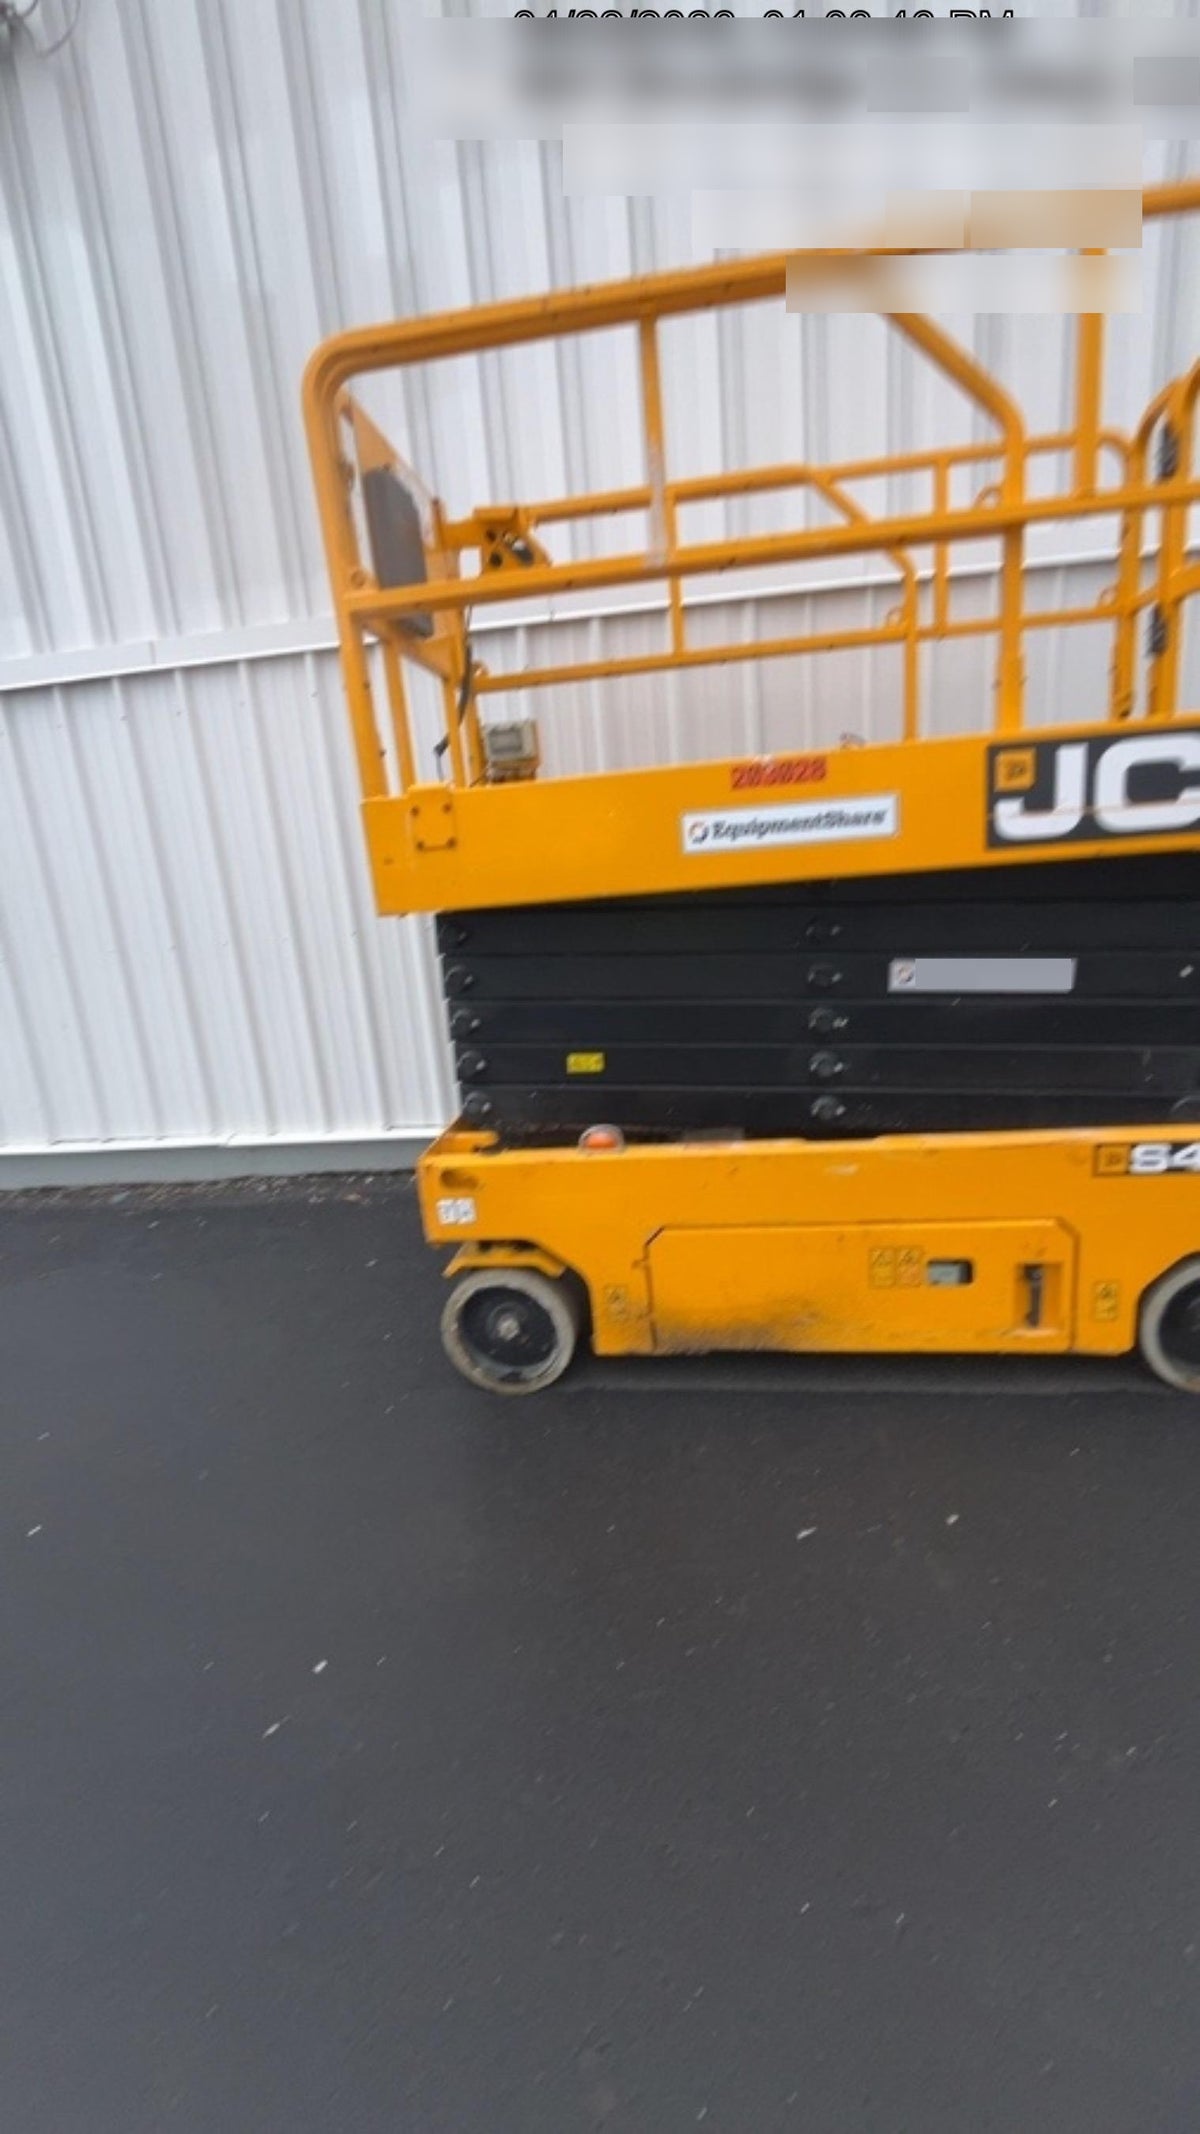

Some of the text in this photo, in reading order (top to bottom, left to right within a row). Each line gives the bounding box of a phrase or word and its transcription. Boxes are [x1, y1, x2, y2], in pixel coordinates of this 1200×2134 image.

[994, 732, 1200, 840] JC
[711, 808, 888, 841] EquipmentShare
[1129, 1143, 1200, 1174] S4
